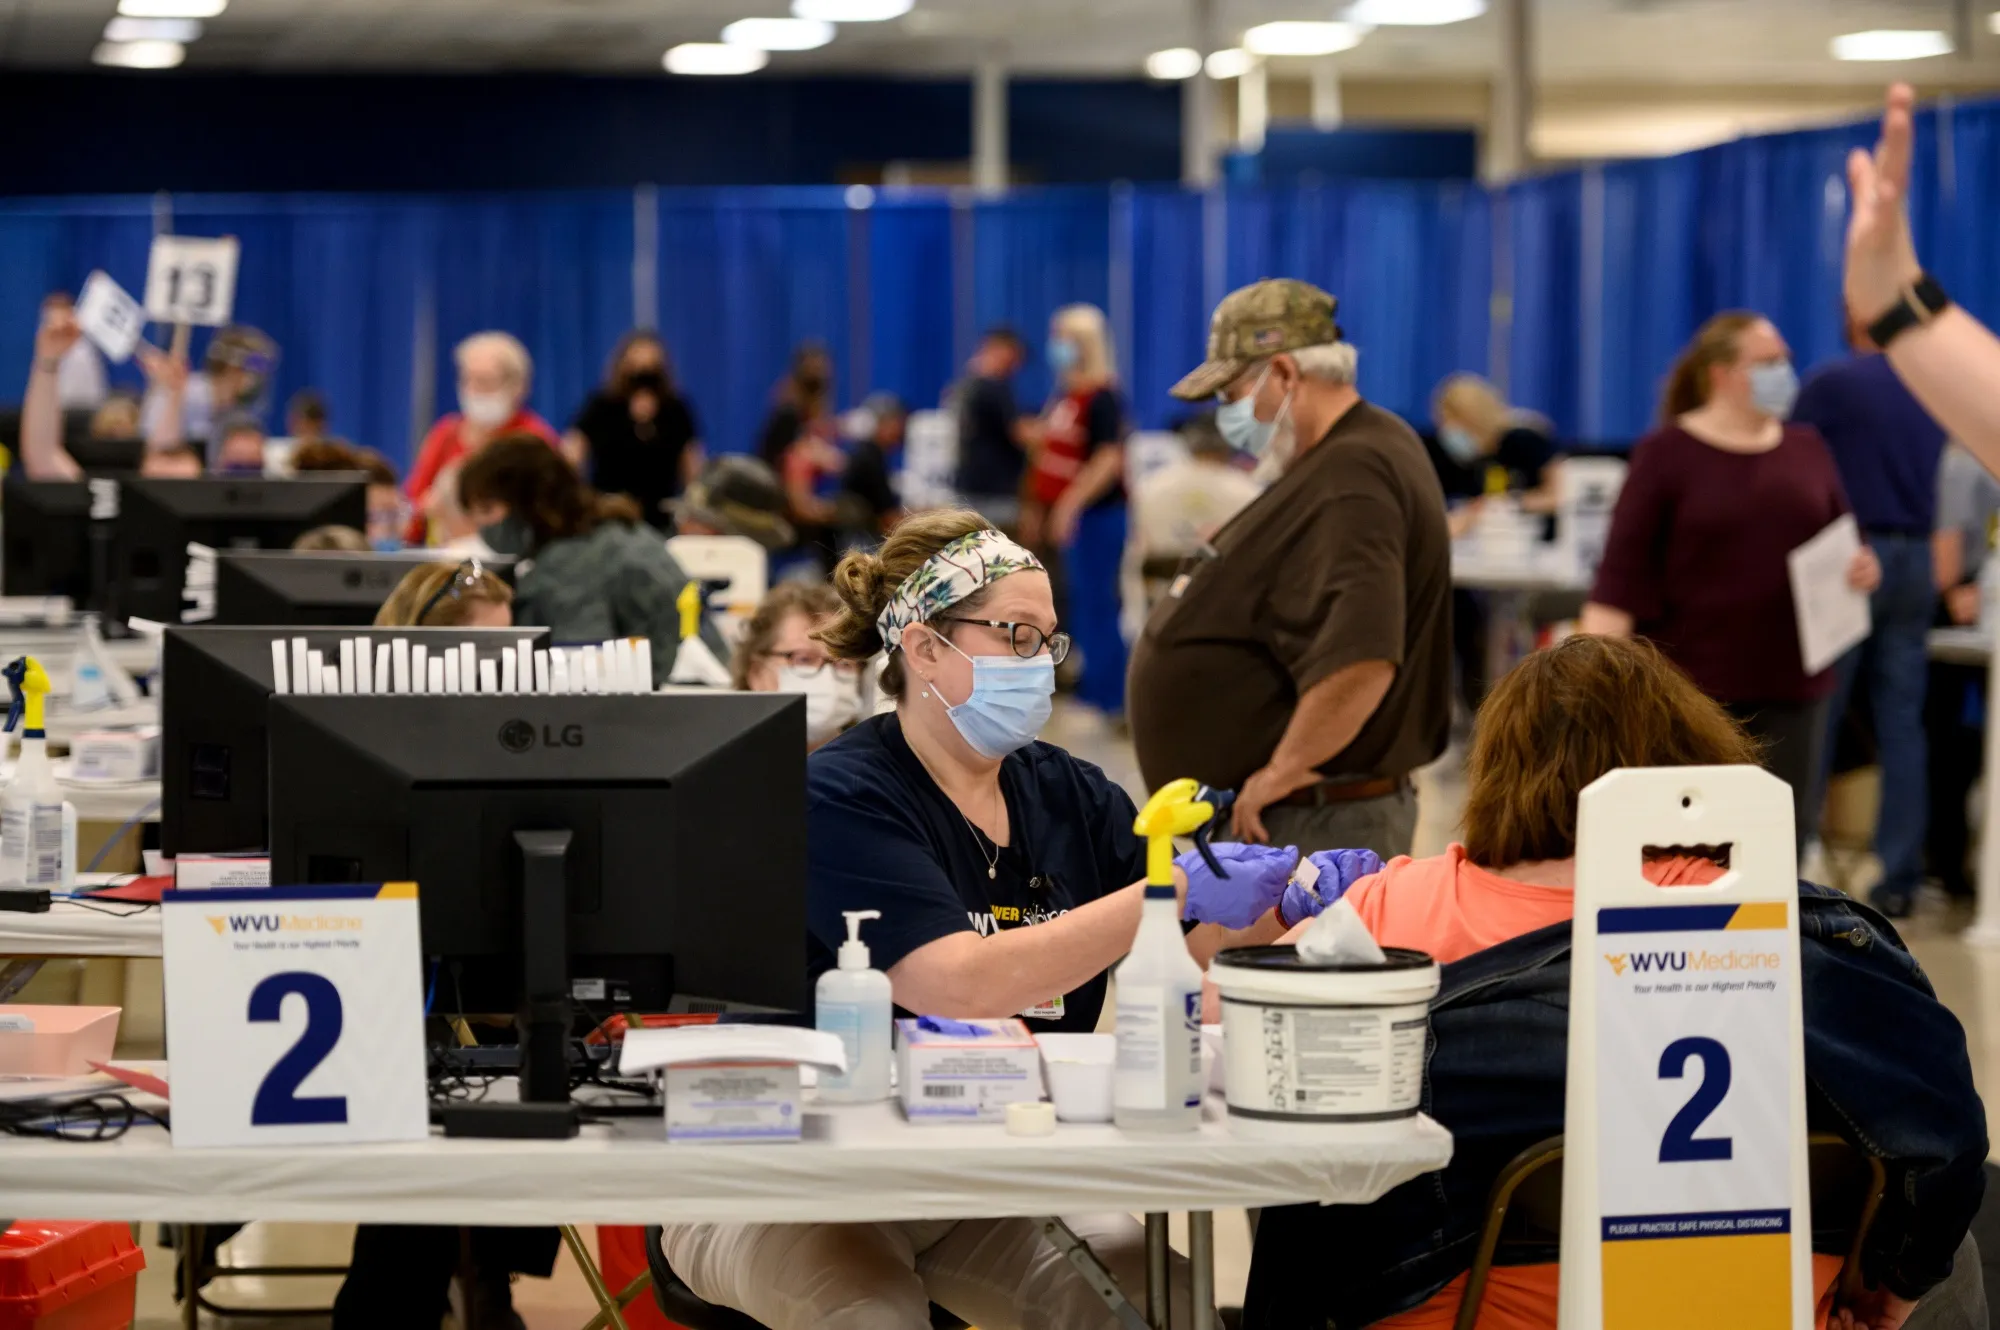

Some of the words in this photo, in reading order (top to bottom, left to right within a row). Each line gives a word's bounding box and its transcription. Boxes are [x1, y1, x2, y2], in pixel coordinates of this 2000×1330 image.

[168, 263, 216, 309] 13
[543, 724, 583, 747] LG
[991, 905, 1020, 921] WER
[1630, 950, 1780, 972] WVUMedicine
[1634, 984, 1651, 993] Your
[1655, 984, 1682, 992] Health
[1686, 984, 1693, 992] is
[1711, 982, 1744, 993] Highest
[1747, 980, 1777, 991] Priority
[247, 971, 348, 1125] 2
[1658, 1036, 1732, 1163] 2
[1609, 1223, 1638, 1235] PLEASE
[1640, 1221, 1676, 1233] PRACTICE
[1678, 1220, 1698, 1231] SAFE
[1699, 1219, 1735, 1230] PHYSICAL
[1737, 1217, 1782, 1229] DISTANCING
